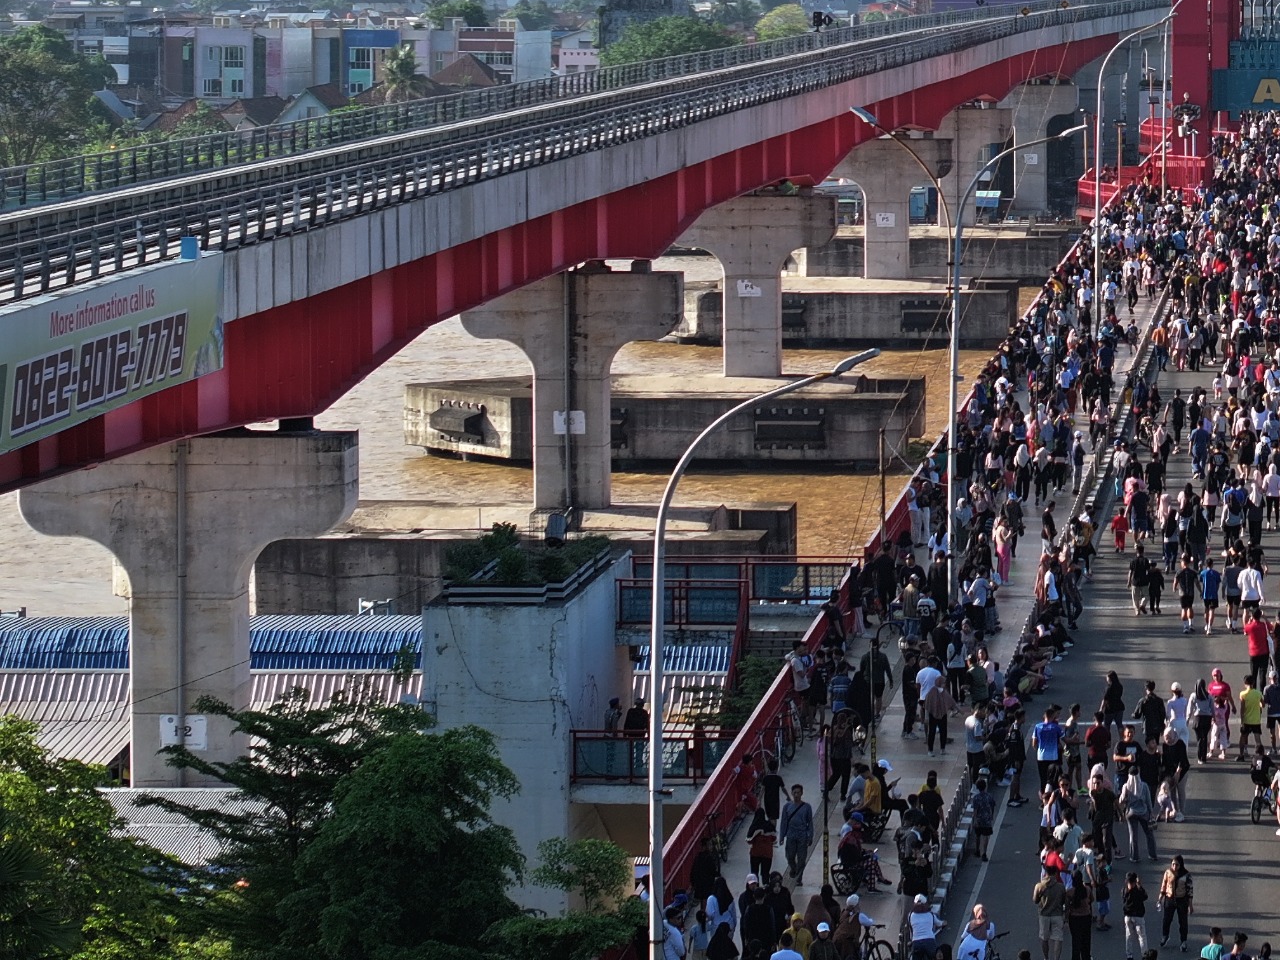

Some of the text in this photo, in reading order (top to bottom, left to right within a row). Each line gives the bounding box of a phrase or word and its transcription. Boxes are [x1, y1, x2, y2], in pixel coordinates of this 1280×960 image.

[50, 284, 155, 338] More information call us
[10, 310, 187, 437] 0822-8012-7779
